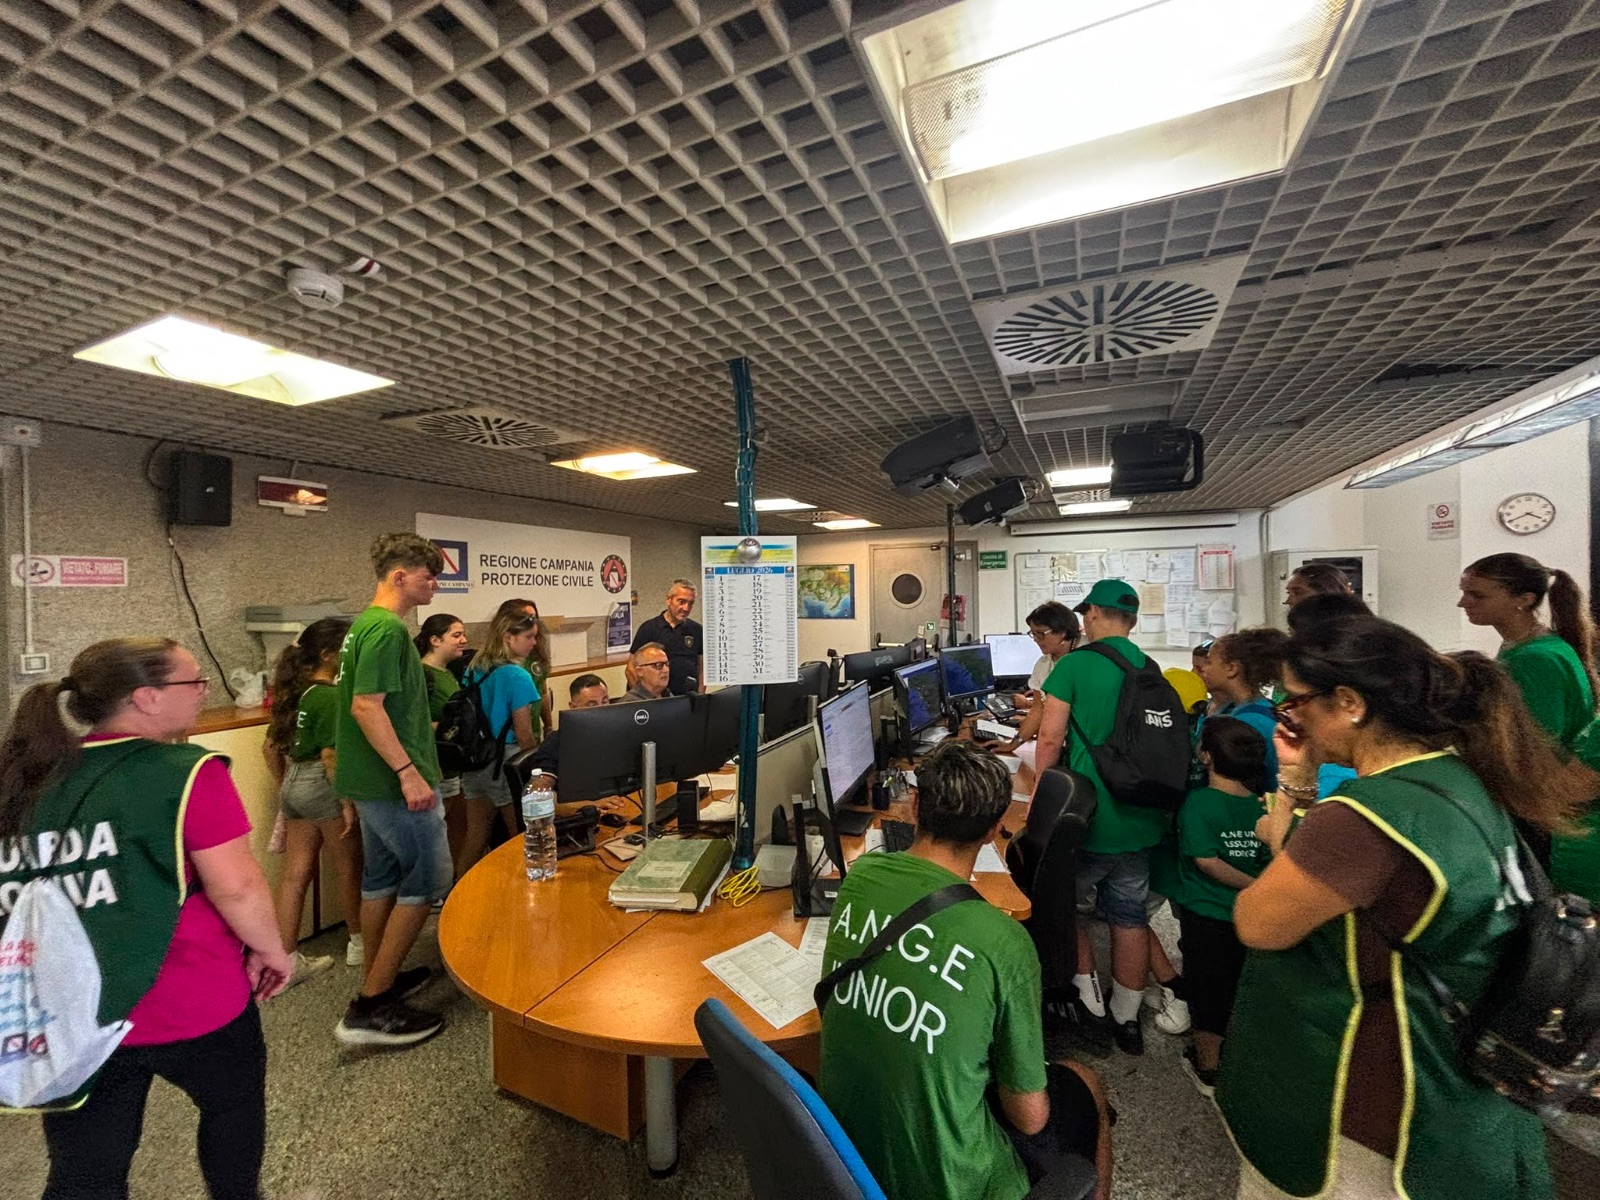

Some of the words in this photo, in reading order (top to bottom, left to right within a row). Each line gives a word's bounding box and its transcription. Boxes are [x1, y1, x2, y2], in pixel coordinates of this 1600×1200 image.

[480, 554, 537, 569] REGIONE
[540, 558, 594, 572] CAMPANIA
[481, 573, 559, 587] PROTEZIONE
[562, 575, 594, 587] CIVILE
[833, 960, 946, 1055] UNIOR
